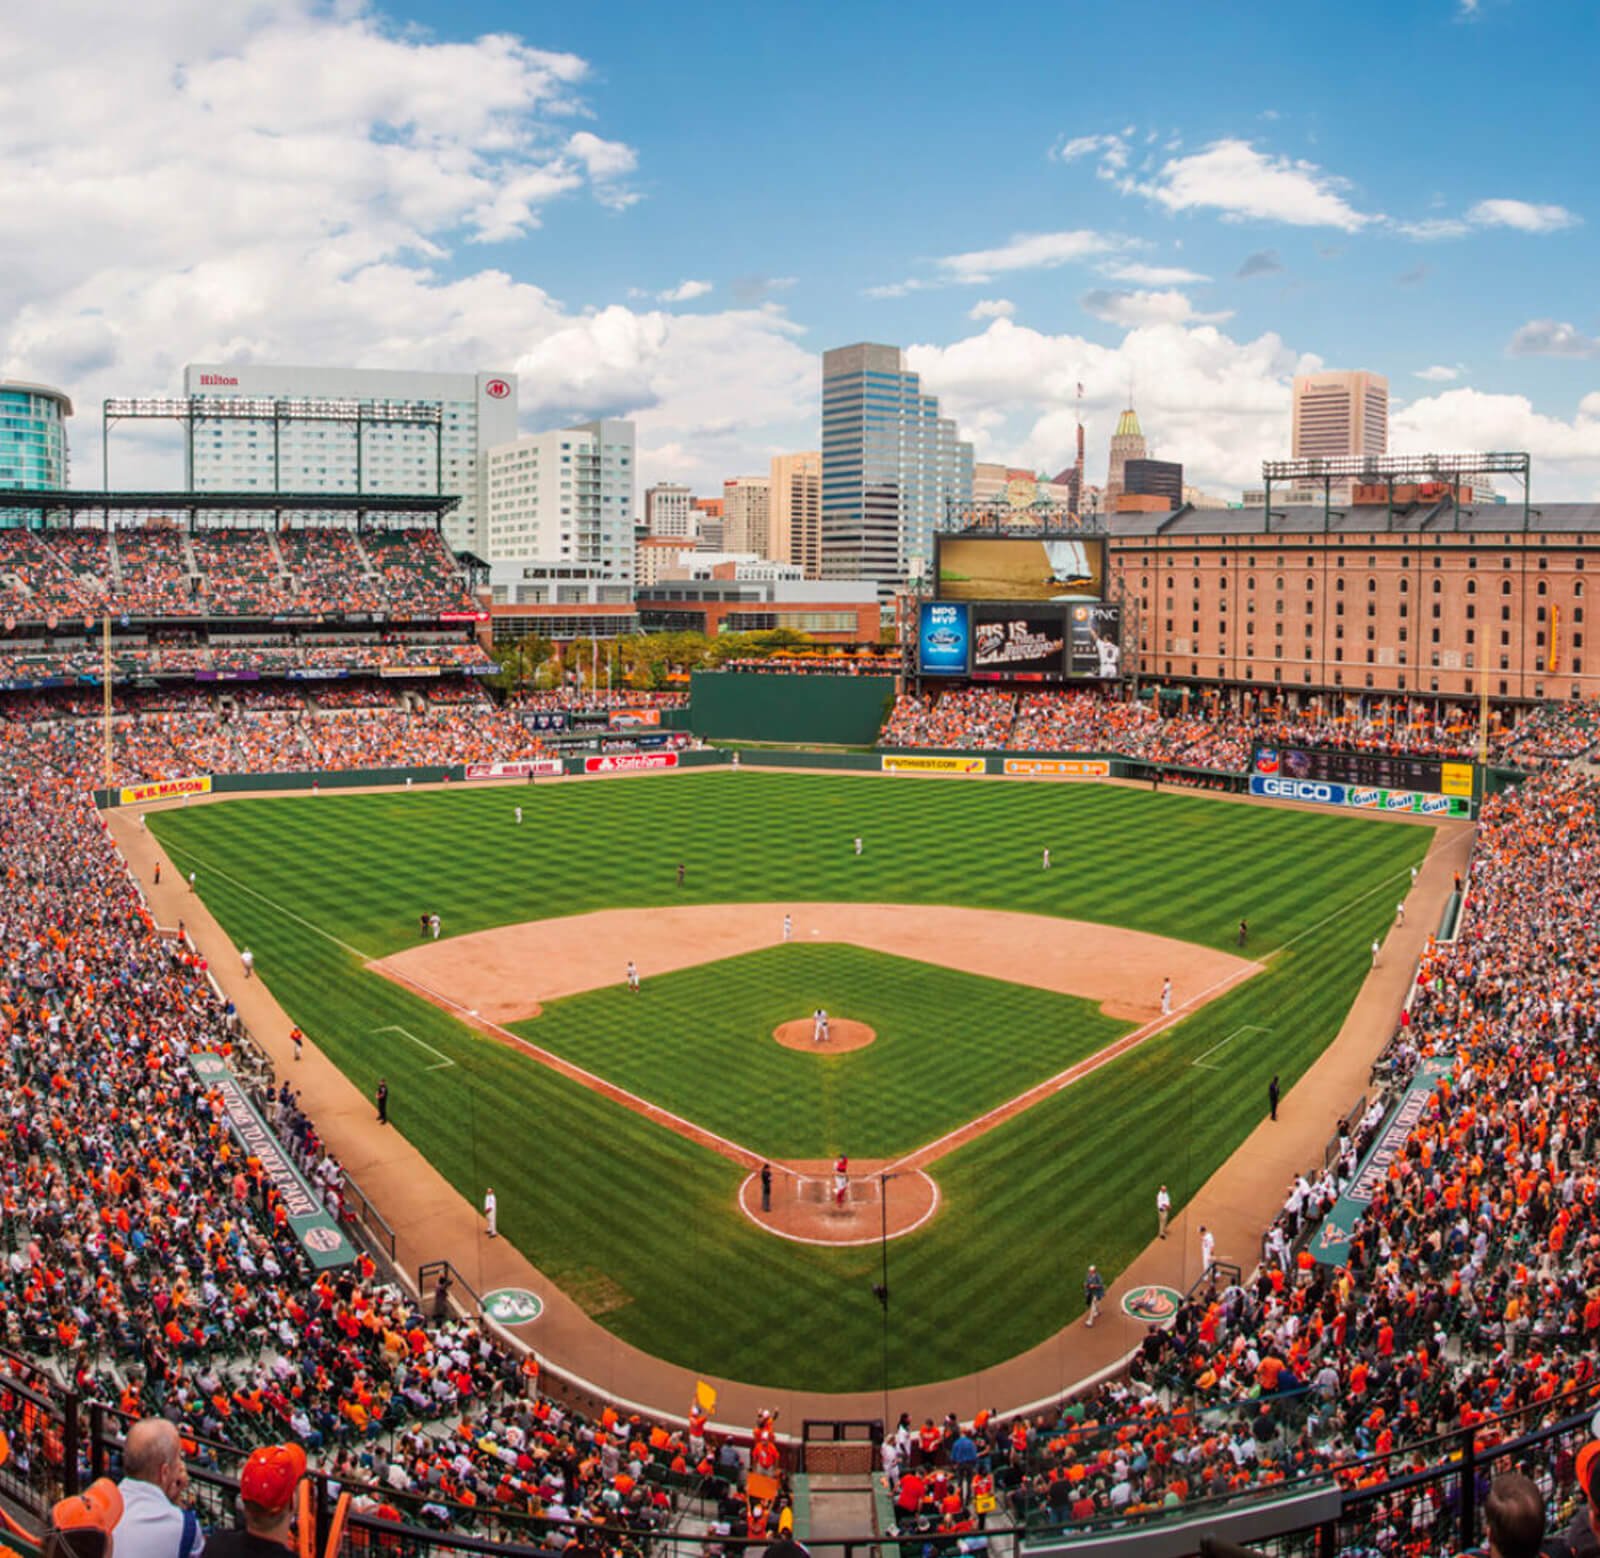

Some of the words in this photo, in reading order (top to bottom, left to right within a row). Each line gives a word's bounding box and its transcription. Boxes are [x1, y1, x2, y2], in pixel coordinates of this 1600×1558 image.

[200, 373, 239, 385] Hilton
[1049, 512, 1084, 528] SUN
[931, 606, 957, 616] MPG
[1089, 608, 1119, 621] PNC
[931, 615, 957, 624] MVP
[885, 758, 957, 769] SOUTHWEST.COM
[160, 781, 203, 794] MASON
[1263, 779, 1332, 800] GEICO
[1353, 791, 1379, 804] Gulf
[1387, 795, 1413, 808] Gulf
[1421, 798, 1449, 811] Gulf
[278, 1182, 316, 1215] PARK
